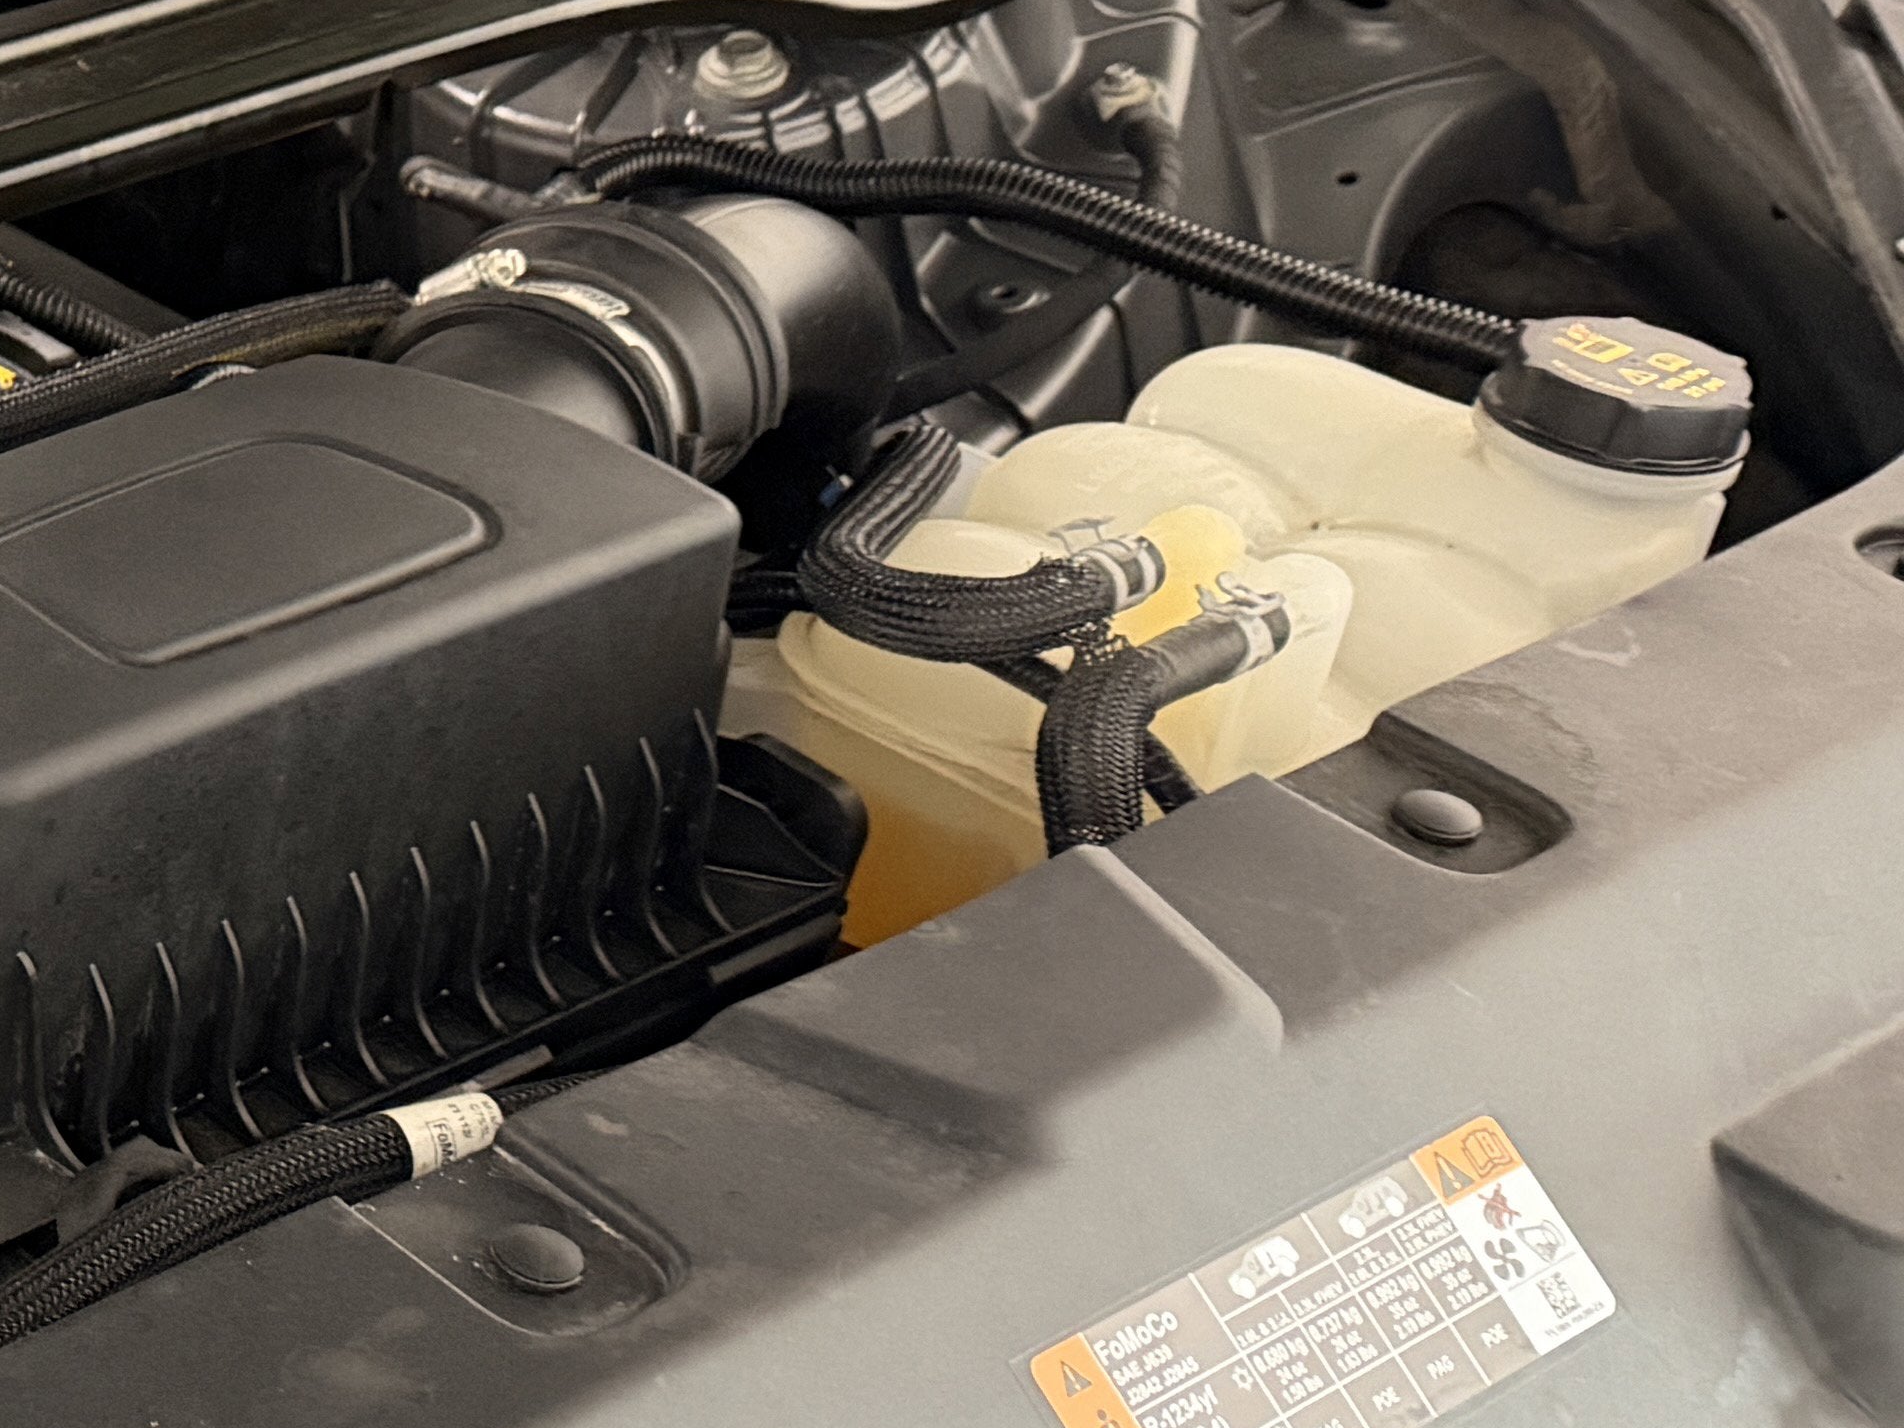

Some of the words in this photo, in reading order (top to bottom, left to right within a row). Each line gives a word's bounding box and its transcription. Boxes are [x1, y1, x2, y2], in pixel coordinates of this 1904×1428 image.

[1450, 1245, 1473, 1263] kg
[1396, 1273, 1420, 1292] kg
[1308, 1312, 1343, 1343] 0.737
[1339, 1306, 1364, 1326] kg
[1480, 1323, 1508, 1349] POE
[1093, 1311, 1178, 1366] FoMoCo
[1284, 1337, 1309, 1356] kg
[1112, 1360, 1143, 1386] SAE
[1426, 1355, 1454, 1380] PAG
[1372, 1386, 1401, 1412] POE
